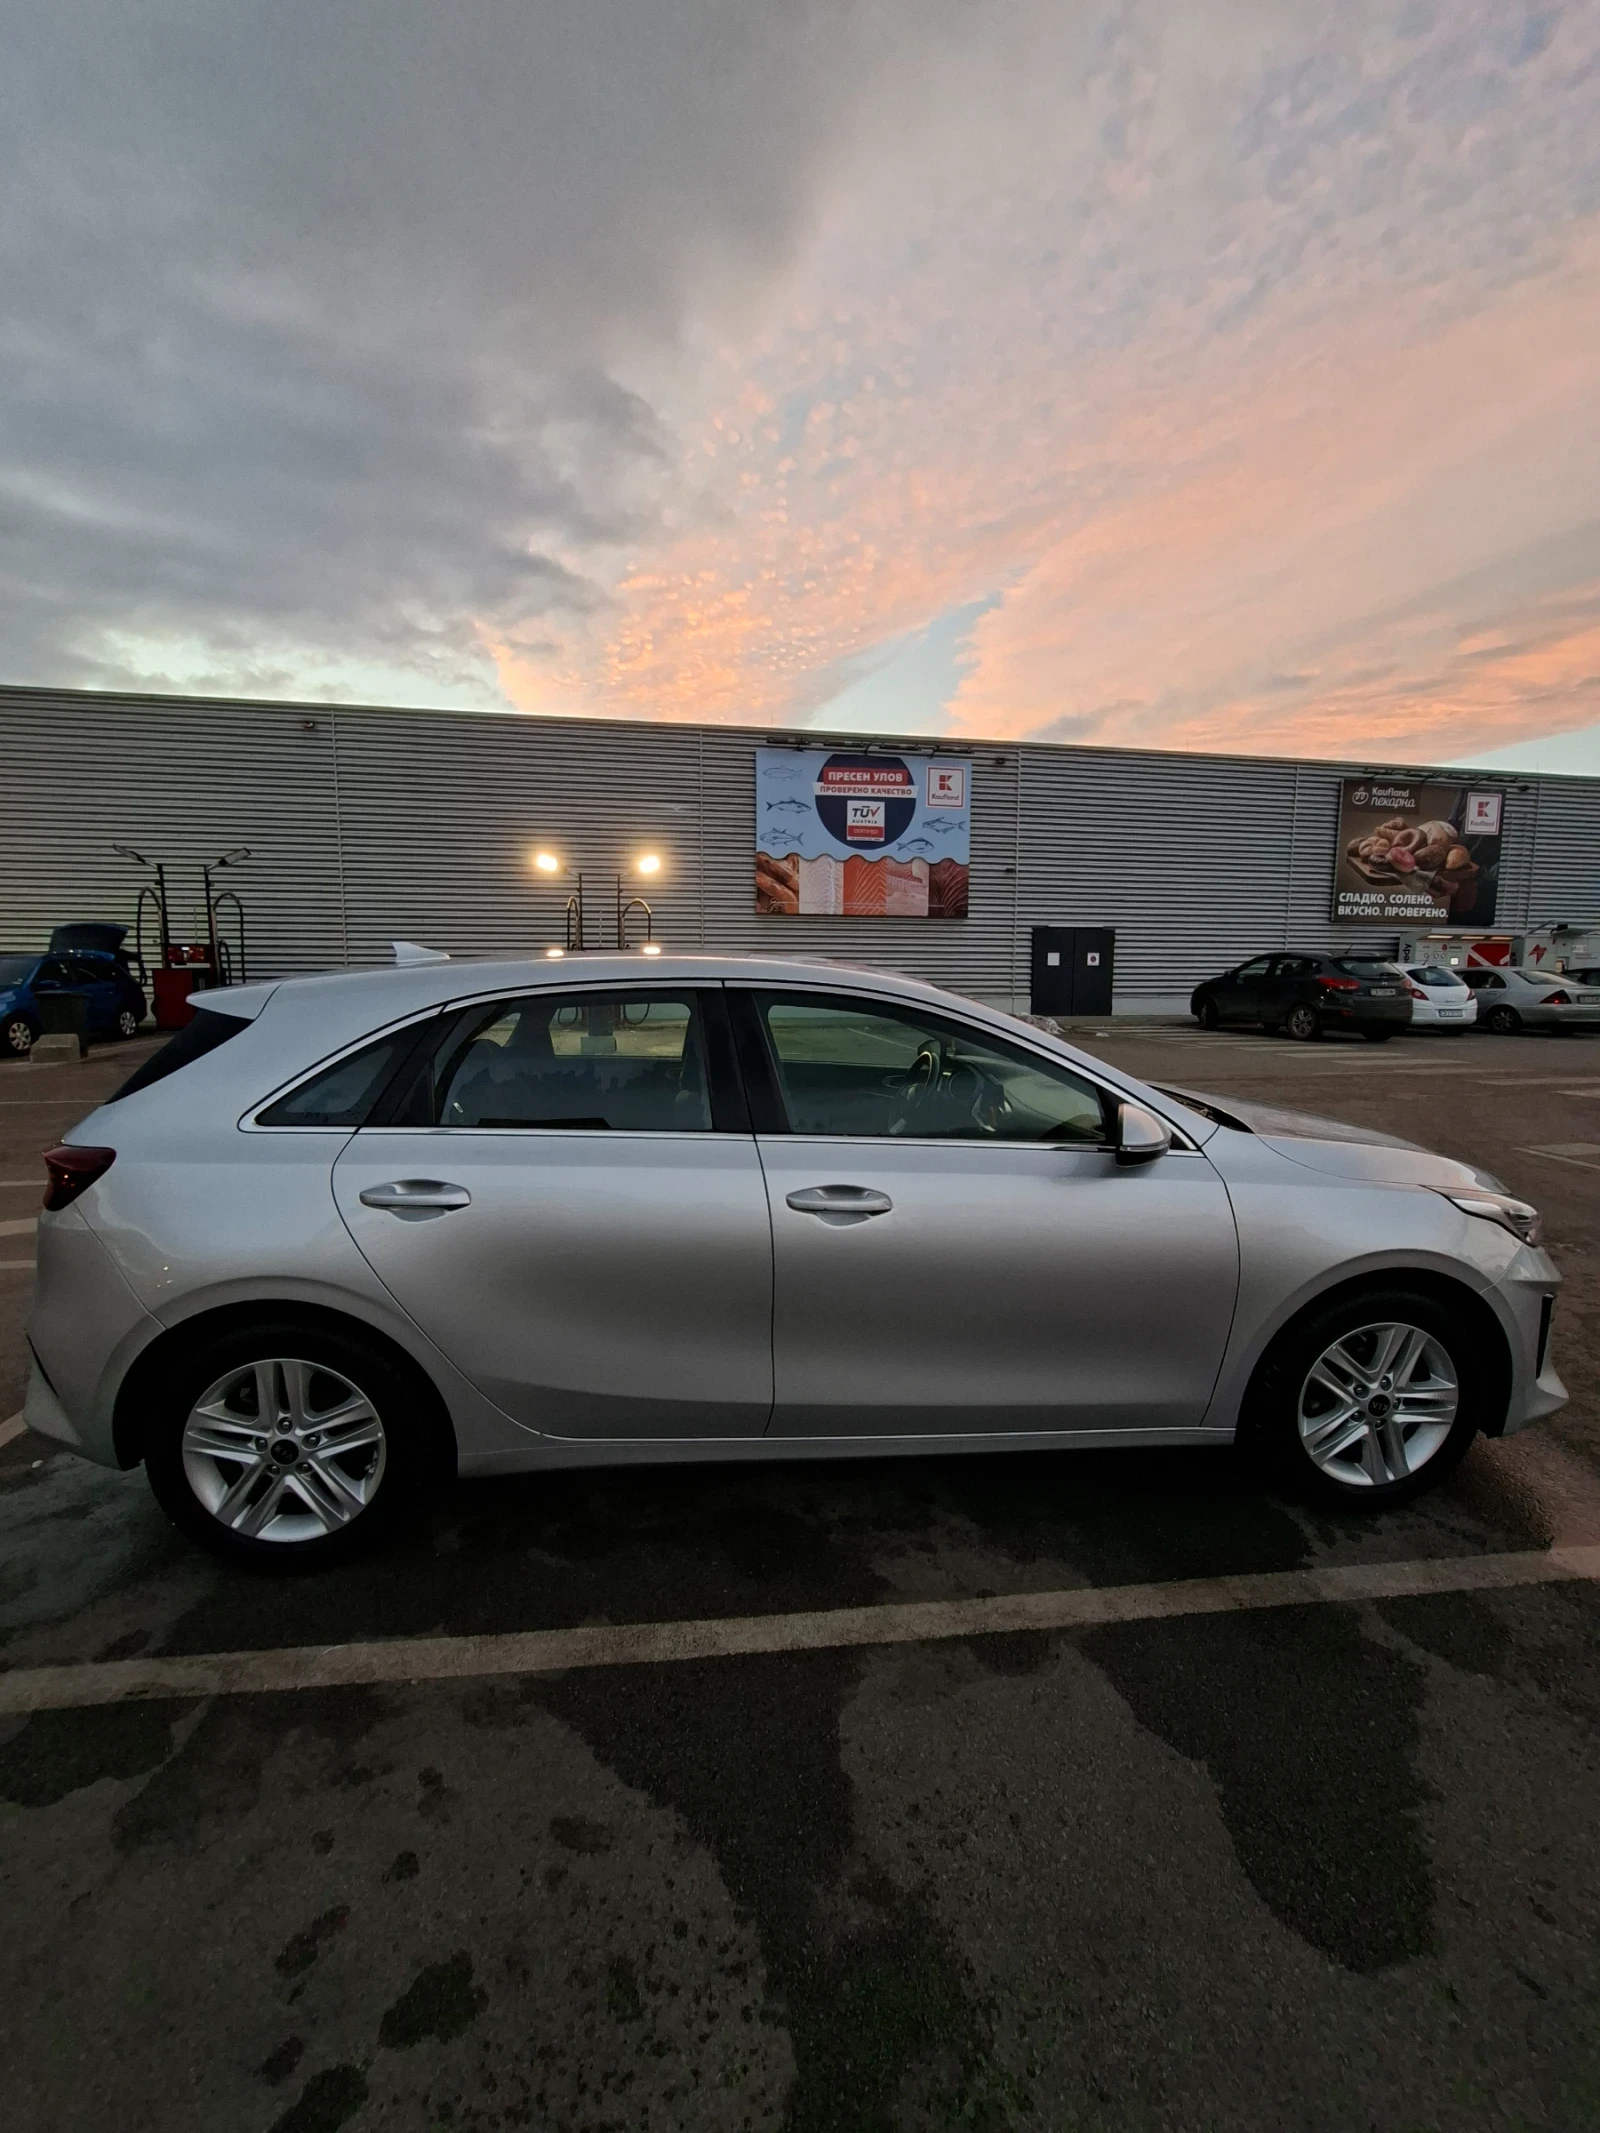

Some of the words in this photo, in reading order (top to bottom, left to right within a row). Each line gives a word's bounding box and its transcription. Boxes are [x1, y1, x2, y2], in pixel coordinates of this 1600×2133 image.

[828, 771, 871, 782] ПРЕСЕН
[873, 772, 903, 783] УЛОВ
[820, 785, 869, 794] ПРОВЕРЕНО
[871, 787, 912, 796] КАЧЕСТВО
[1372, 786, 1410, 798] Kaufland
[932, 793, 959, 801] Kaufland
[1339, 892, 1387, 905] СЛАДКО.
[1389, 894, 1434, 905] СОЛЕНО.
[1338, 906, 1381, 916] ВКУСНО.
[1384, 907, 1449, 918] ПРОВЕРЕНО.
